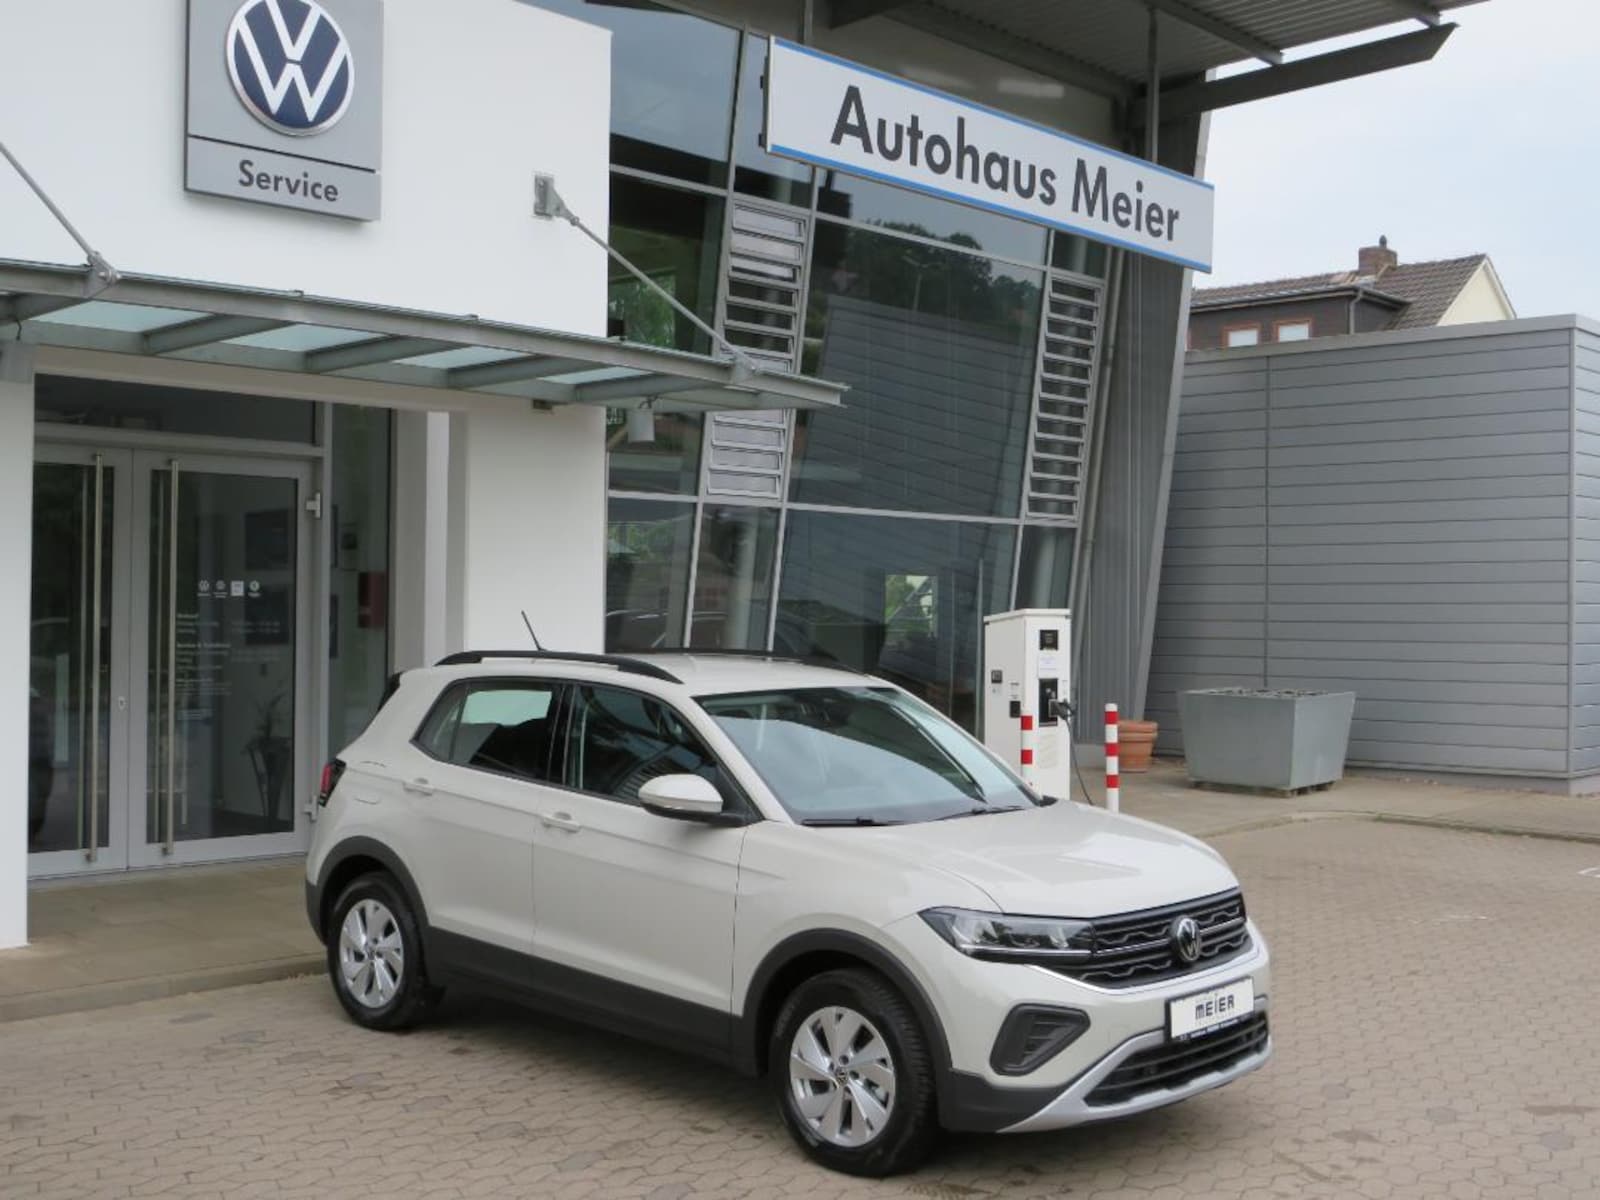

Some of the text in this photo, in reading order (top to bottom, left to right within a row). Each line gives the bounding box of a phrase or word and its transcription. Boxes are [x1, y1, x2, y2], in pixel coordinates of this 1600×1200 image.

[238, 159, 339, 202] Service
[830, 84, 1180, 242] Autohaus Meier
[1195, 994, 1235, 1020] MEIER
